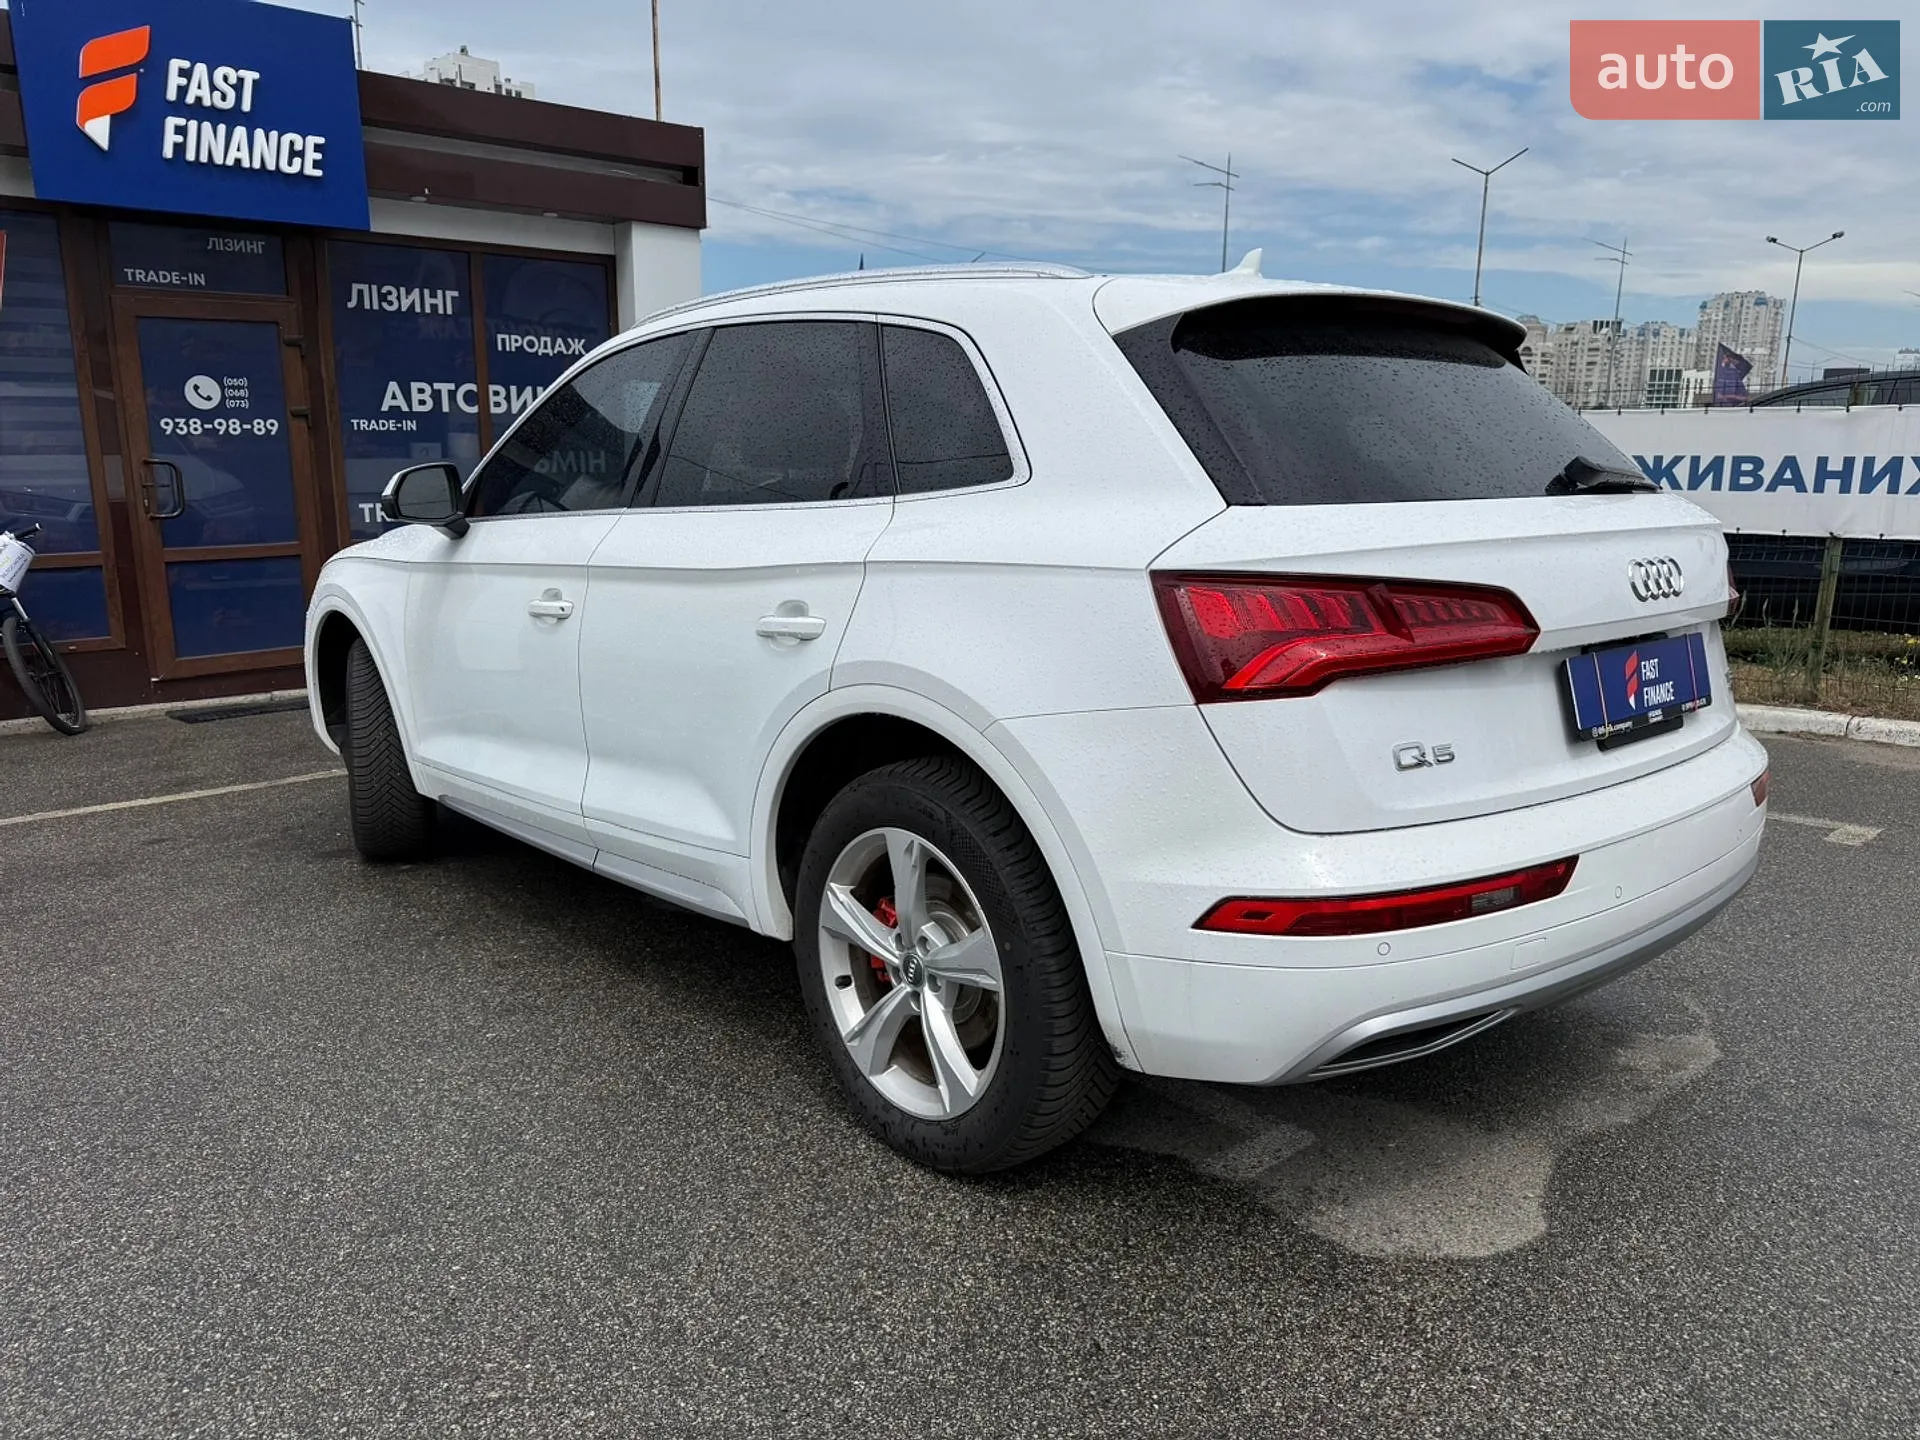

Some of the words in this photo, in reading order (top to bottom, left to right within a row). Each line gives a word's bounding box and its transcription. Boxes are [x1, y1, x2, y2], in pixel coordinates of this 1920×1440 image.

[165, 58, 260, 113] FAST
[162, 116, 326, 177] FINANCE
[207, 236, 266, 254] ЛІЗИНГ
[124, 267, 206, 286] TRADE-IN
[347, 283, 460, 315] ЛІЗИНГ
[225, 398, 250, 409] (073)
[159, 418, 279, 435] 938-98-89
[351, 419, 417, 431] TRADE-IN
[1641, 658, 1659, 681] FAST
[1643, 681, 1675, 708] FINANCE
[1392, 741, 1456, 772] Q5
